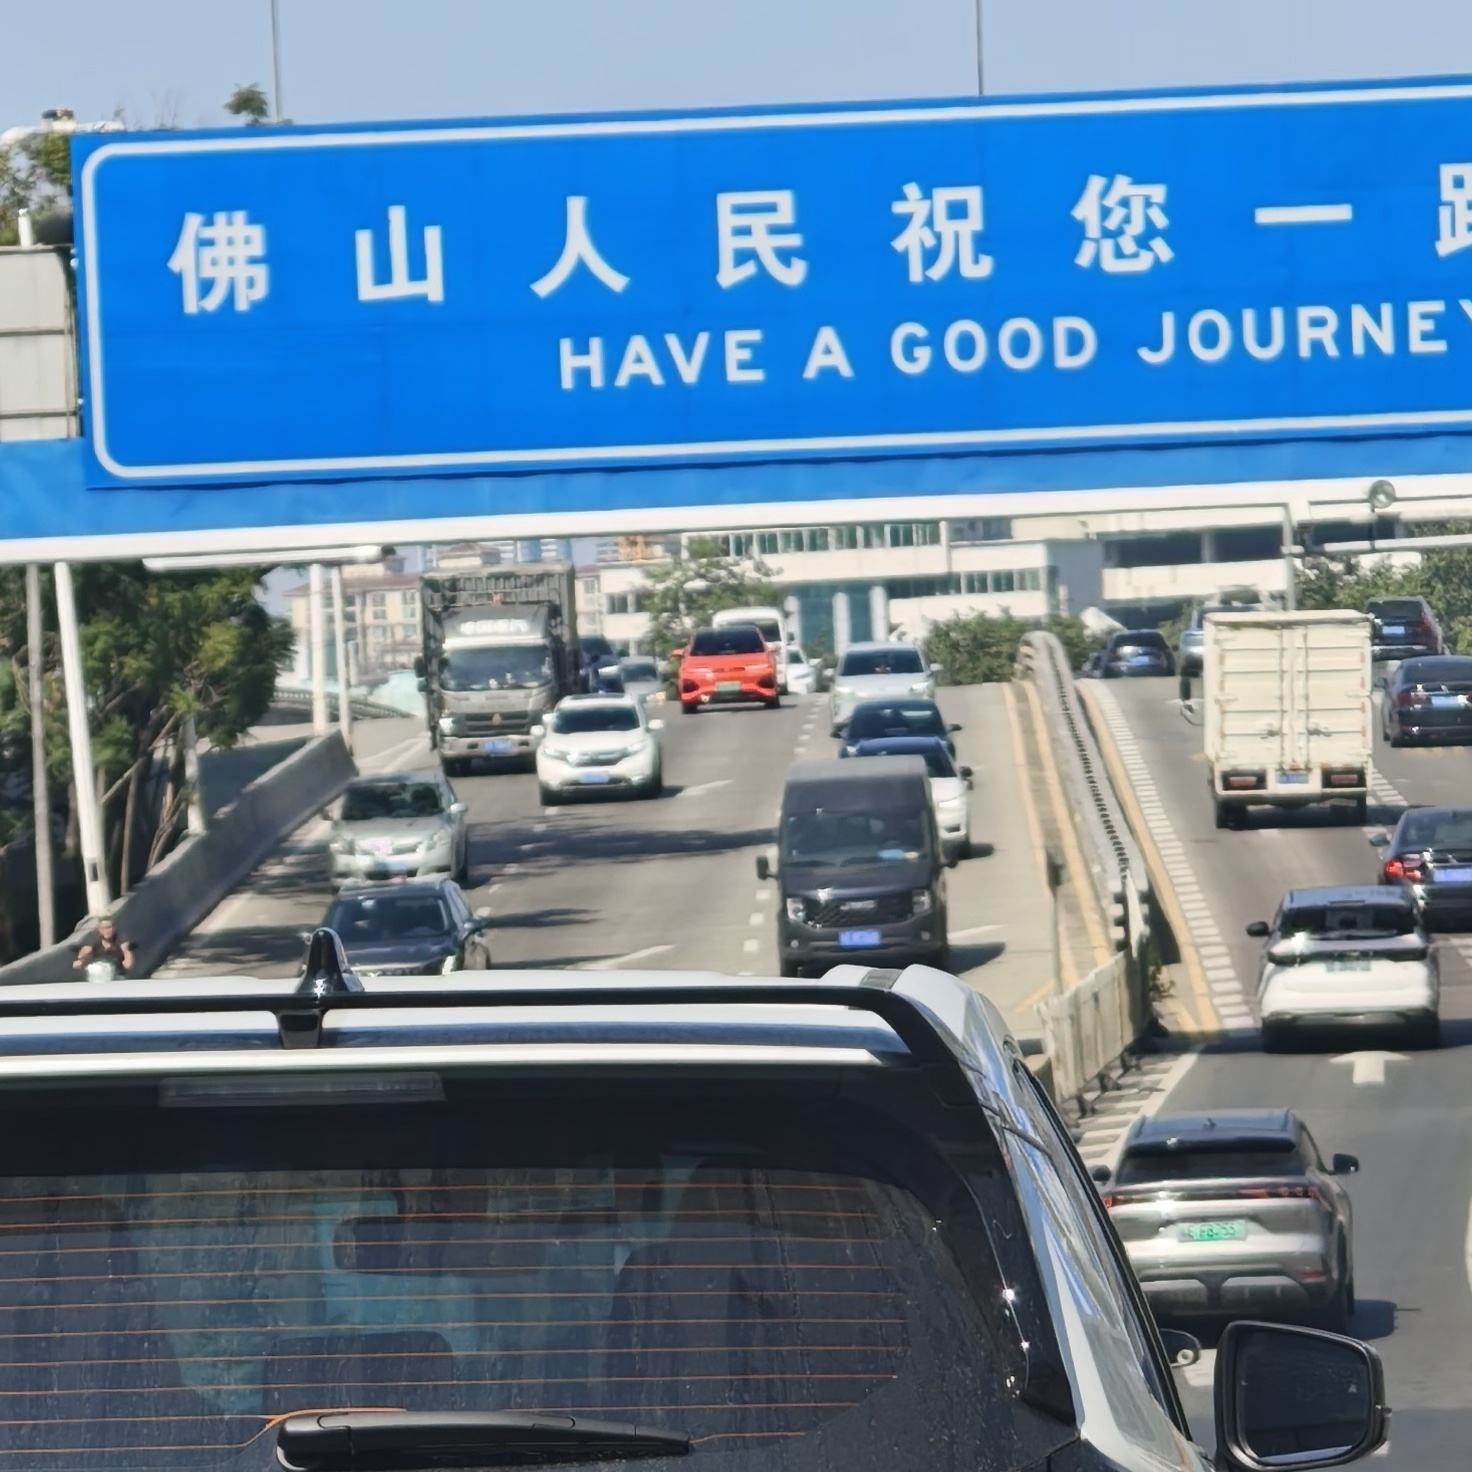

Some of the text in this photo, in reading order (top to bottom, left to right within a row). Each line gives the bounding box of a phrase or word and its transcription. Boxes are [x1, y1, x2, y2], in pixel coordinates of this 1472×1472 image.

[560, 330, 765, 389] HAVE
[803, 326, 853, 380] A
[891, 317, 1097, 375] GOOD
